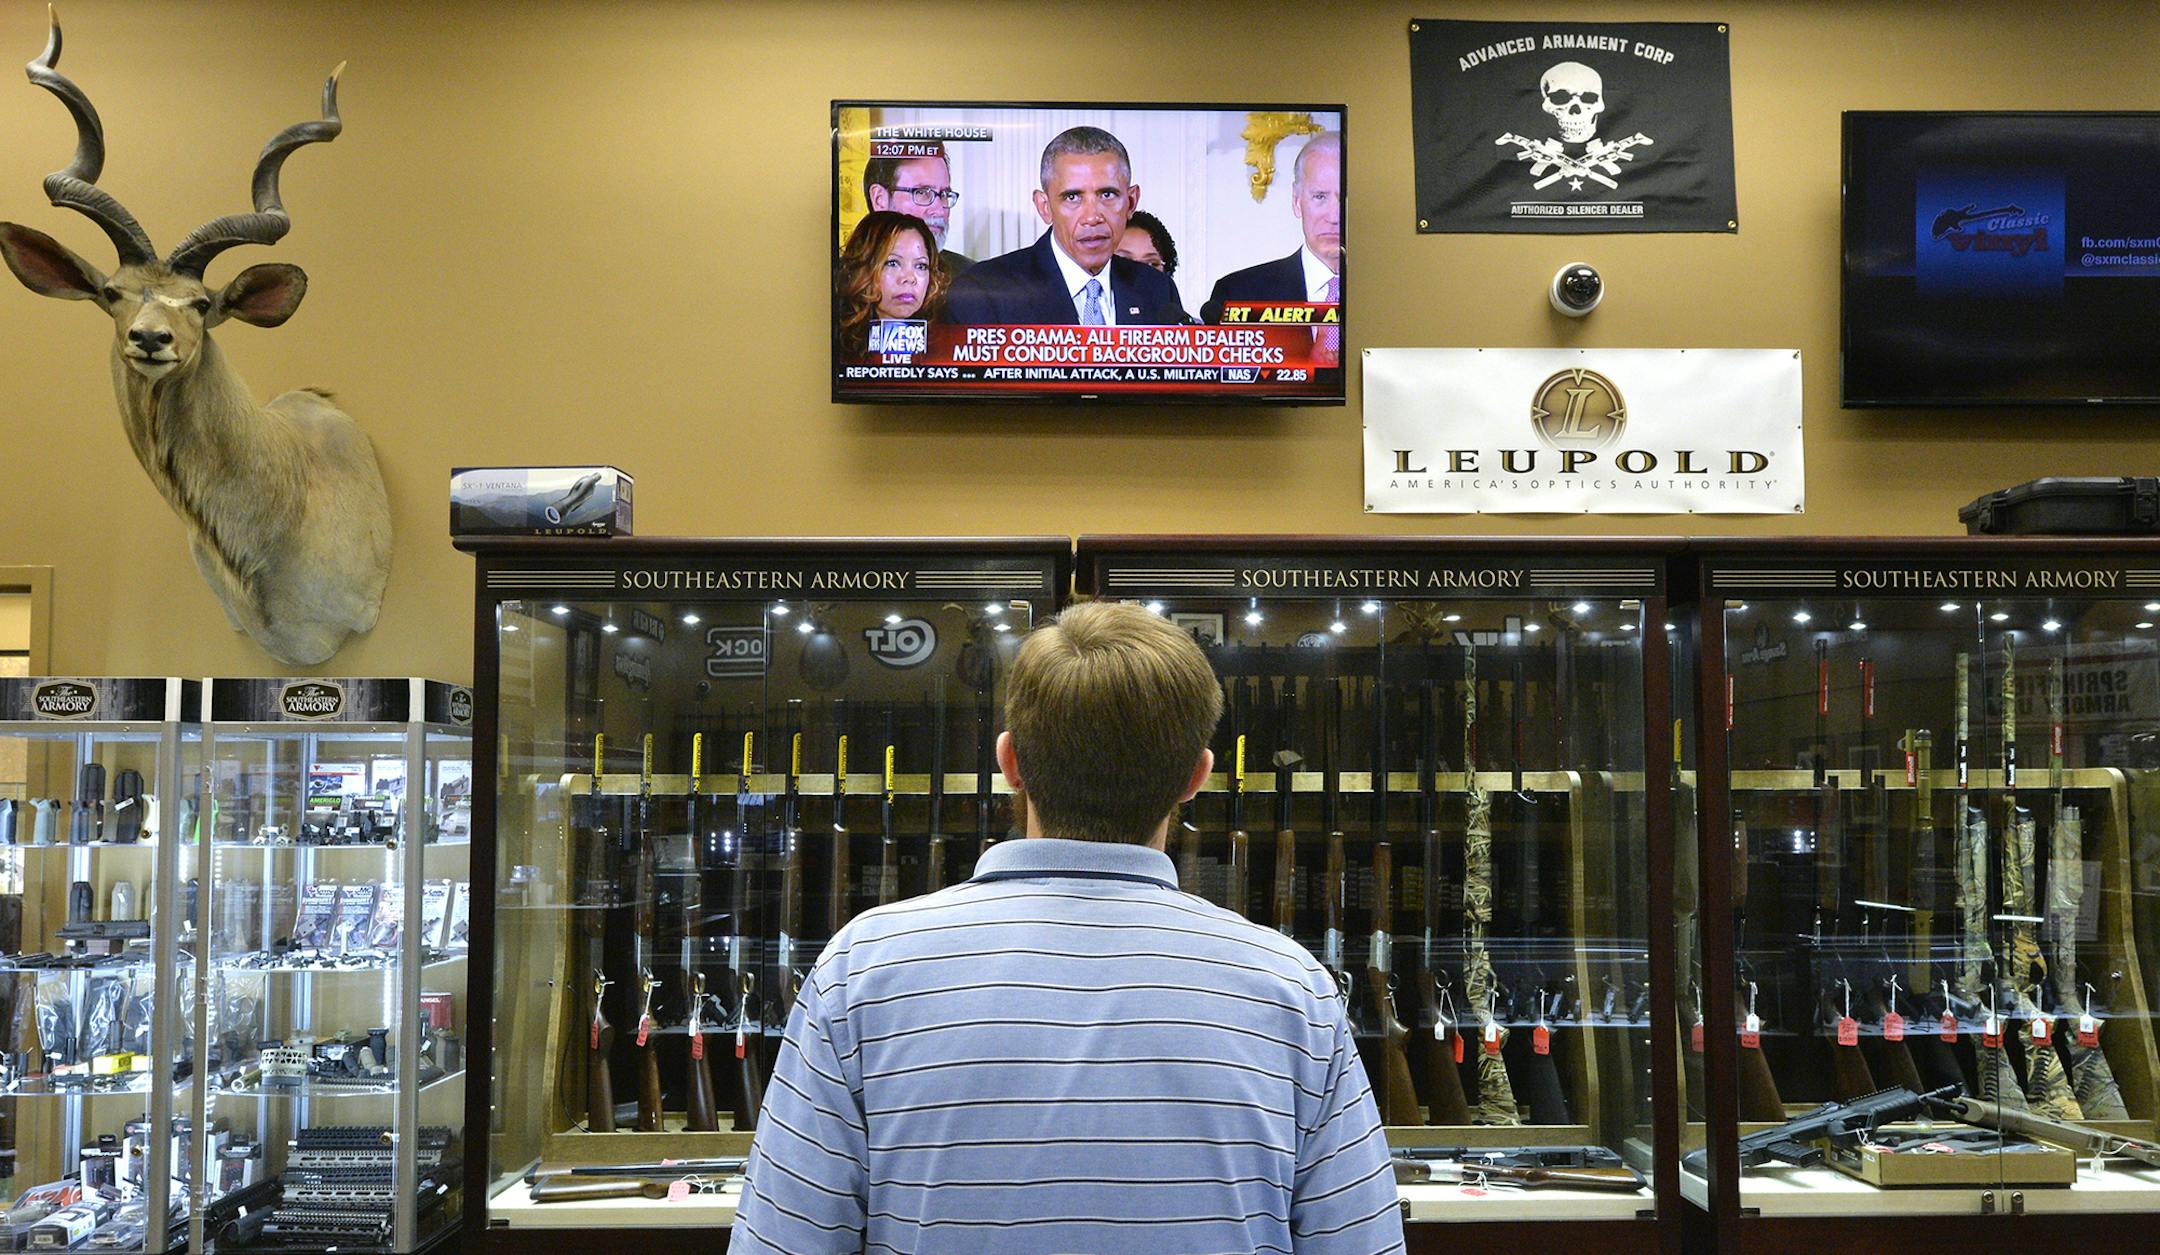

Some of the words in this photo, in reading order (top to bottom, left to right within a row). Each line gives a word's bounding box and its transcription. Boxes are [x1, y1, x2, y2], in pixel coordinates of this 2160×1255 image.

[1458, 37, 1536, 71] ADVANCED
[1542, 34, 1628, 53] ARMAMENT
[1634, 42, 1675, 65] CORP
[875, 127, 899, 138] THE
[903, 127, 942, 138] WHITE
[945, 127, 987, 138] HOUSE
[876, 145, 904, 156] 12:07
[908, 145, 925, 155] PM
[927, 147, 939, 155] ET
[1511, 205, 1565, 215] AUTHORIZED
[1566, 205, 1608, 215] SILENCER
[1610, 205, 1644, 214] DEALER
[1987, 213, 2049, 231] Classic
[2081, 252, 2160, 267] @sxmclassi
[1260, 307, 1315, 323] ALERT
[899, 326, 925, 339] FOX
[967, 328, 1007, 345] PRES
[1010, 328, 1082, 345] OBAMA:
[1088, 329, 1115, 345] ALL
[1119, 330, 1190, 346] FIREARM
[1195, 330, 1265, 346] DEALERS
[889, 338, 925, 352] NEWS
[882, 354, 912, 364] LIVE
[953, 345, 999, 361] MUST
[1003, 345, 1088, 362] CONDUCT
[1093, 347, 1214, 363] BACKGROUND
[1218, 347, 1284, 363] CHECKS
[846, 367, 926, 378] REPORTEDLY
[928, 367, 958, 378] SAYS
[984, 368, 1023, 379] AFTER
[1025, 368, 1067, 379] INITIAL
[1070, 369, 1122, 381] ATTACK,
[1125, 370, 1134, 379] A
[1138, 369, 1160, 380] U.S.
[1164, 369, 1219, 380] MILITARY
[1229, 369, 1251, 380] NAS
[1277, 369, 1307, 381] 22.85
[1392, 449, 1770, 474] LEUPOLD
[1390, 479, 1518, 489] AMERICA'S
[1531, 479, 1617, 489] OPTICS
[1634, 479, 1774, 489] AUTHORITY
[622, 570, 802, 589] SOUTHEASTERN
[811, 570, 909, 589] ARMORY
[1241, 569, 1419, 588] SOUTHEASTERN
[1427, 569, 1524, 588] ARMORY
[1843, 570, 2017, 588] SOUTHEASTERN
[2025, 570, 2120, 588] ARMORY
[38, 695, 93, 703] SOUTHEASTERN
[285, 695, 339, 703] SOUTHEASTERN
[40, 701, 90, 712] ARMORY
[287, 701, 337, 712] ARMORY
